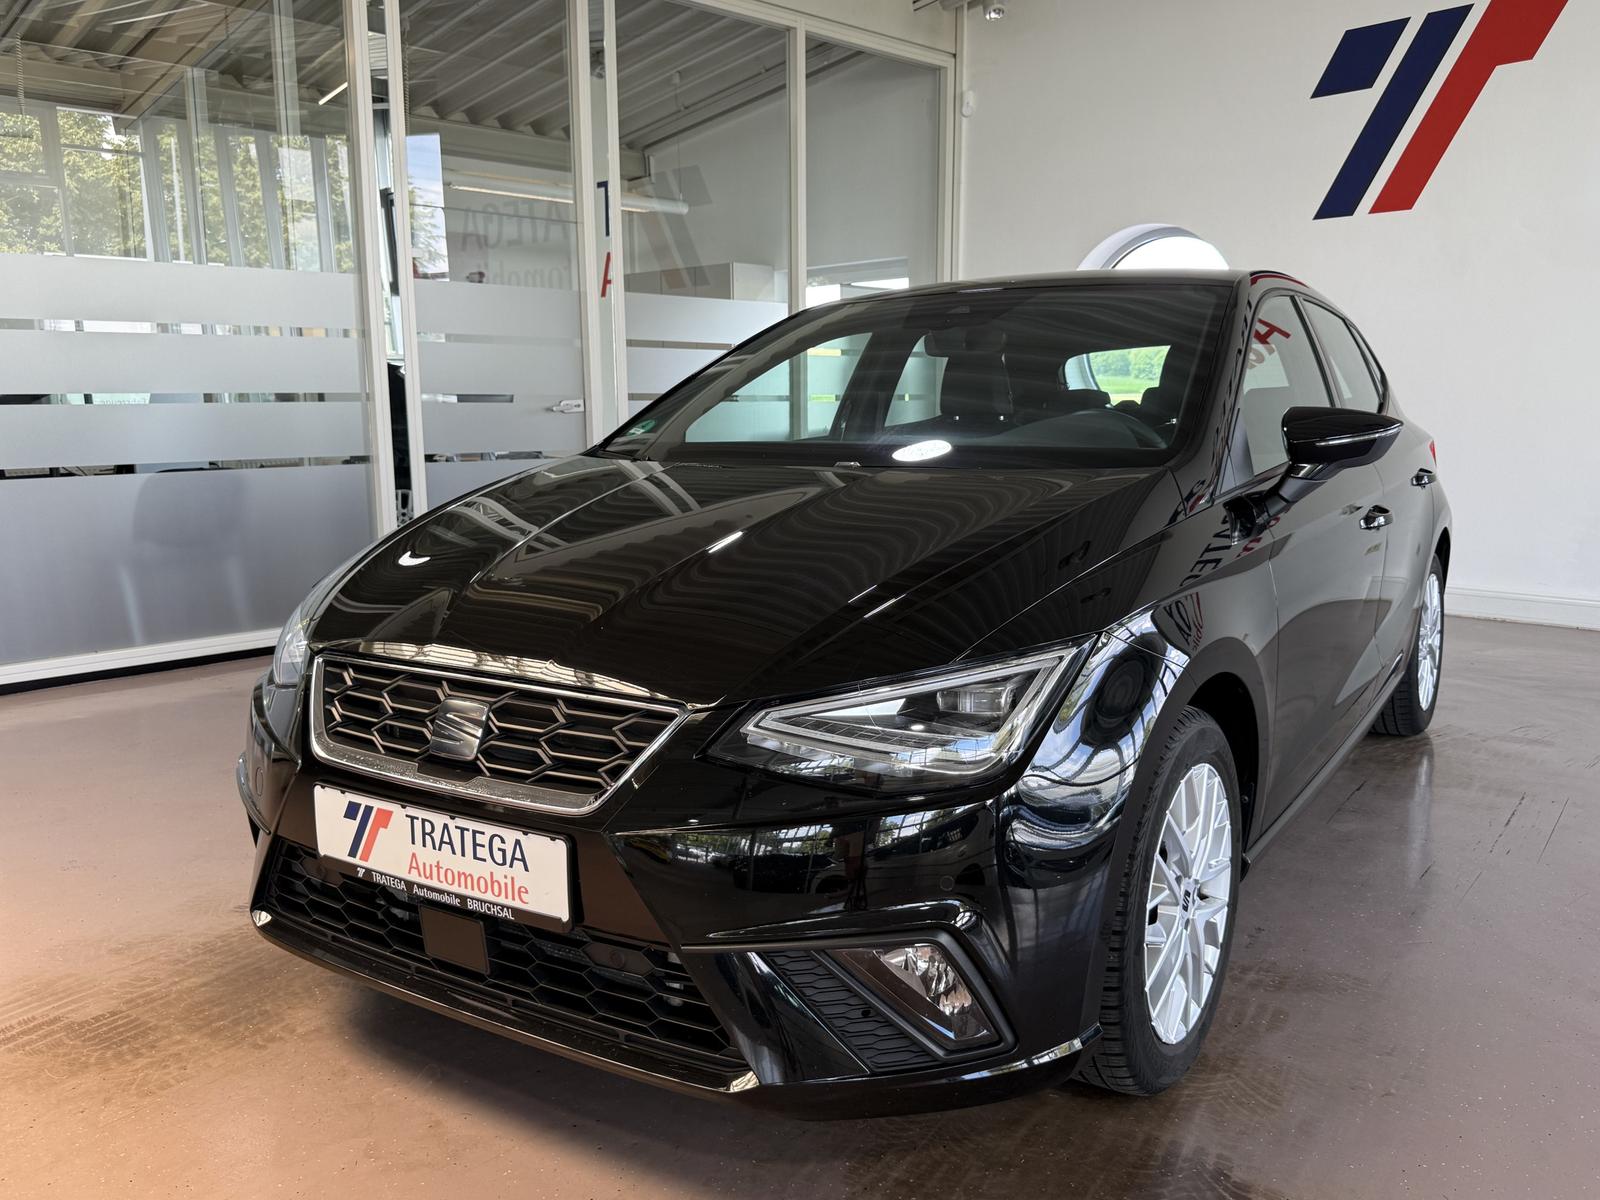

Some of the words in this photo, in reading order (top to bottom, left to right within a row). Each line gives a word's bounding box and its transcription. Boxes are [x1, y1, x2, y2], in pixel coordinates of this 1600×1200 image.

[405, 814, 529, 872] TRATEGA
[372, 871, 407, 892] TRATEGA
[413, 880, 461, 907] Automobile
[467, 899, 515, 920] BRUCHSAL
[408, 852, 529, 905] Automobile
